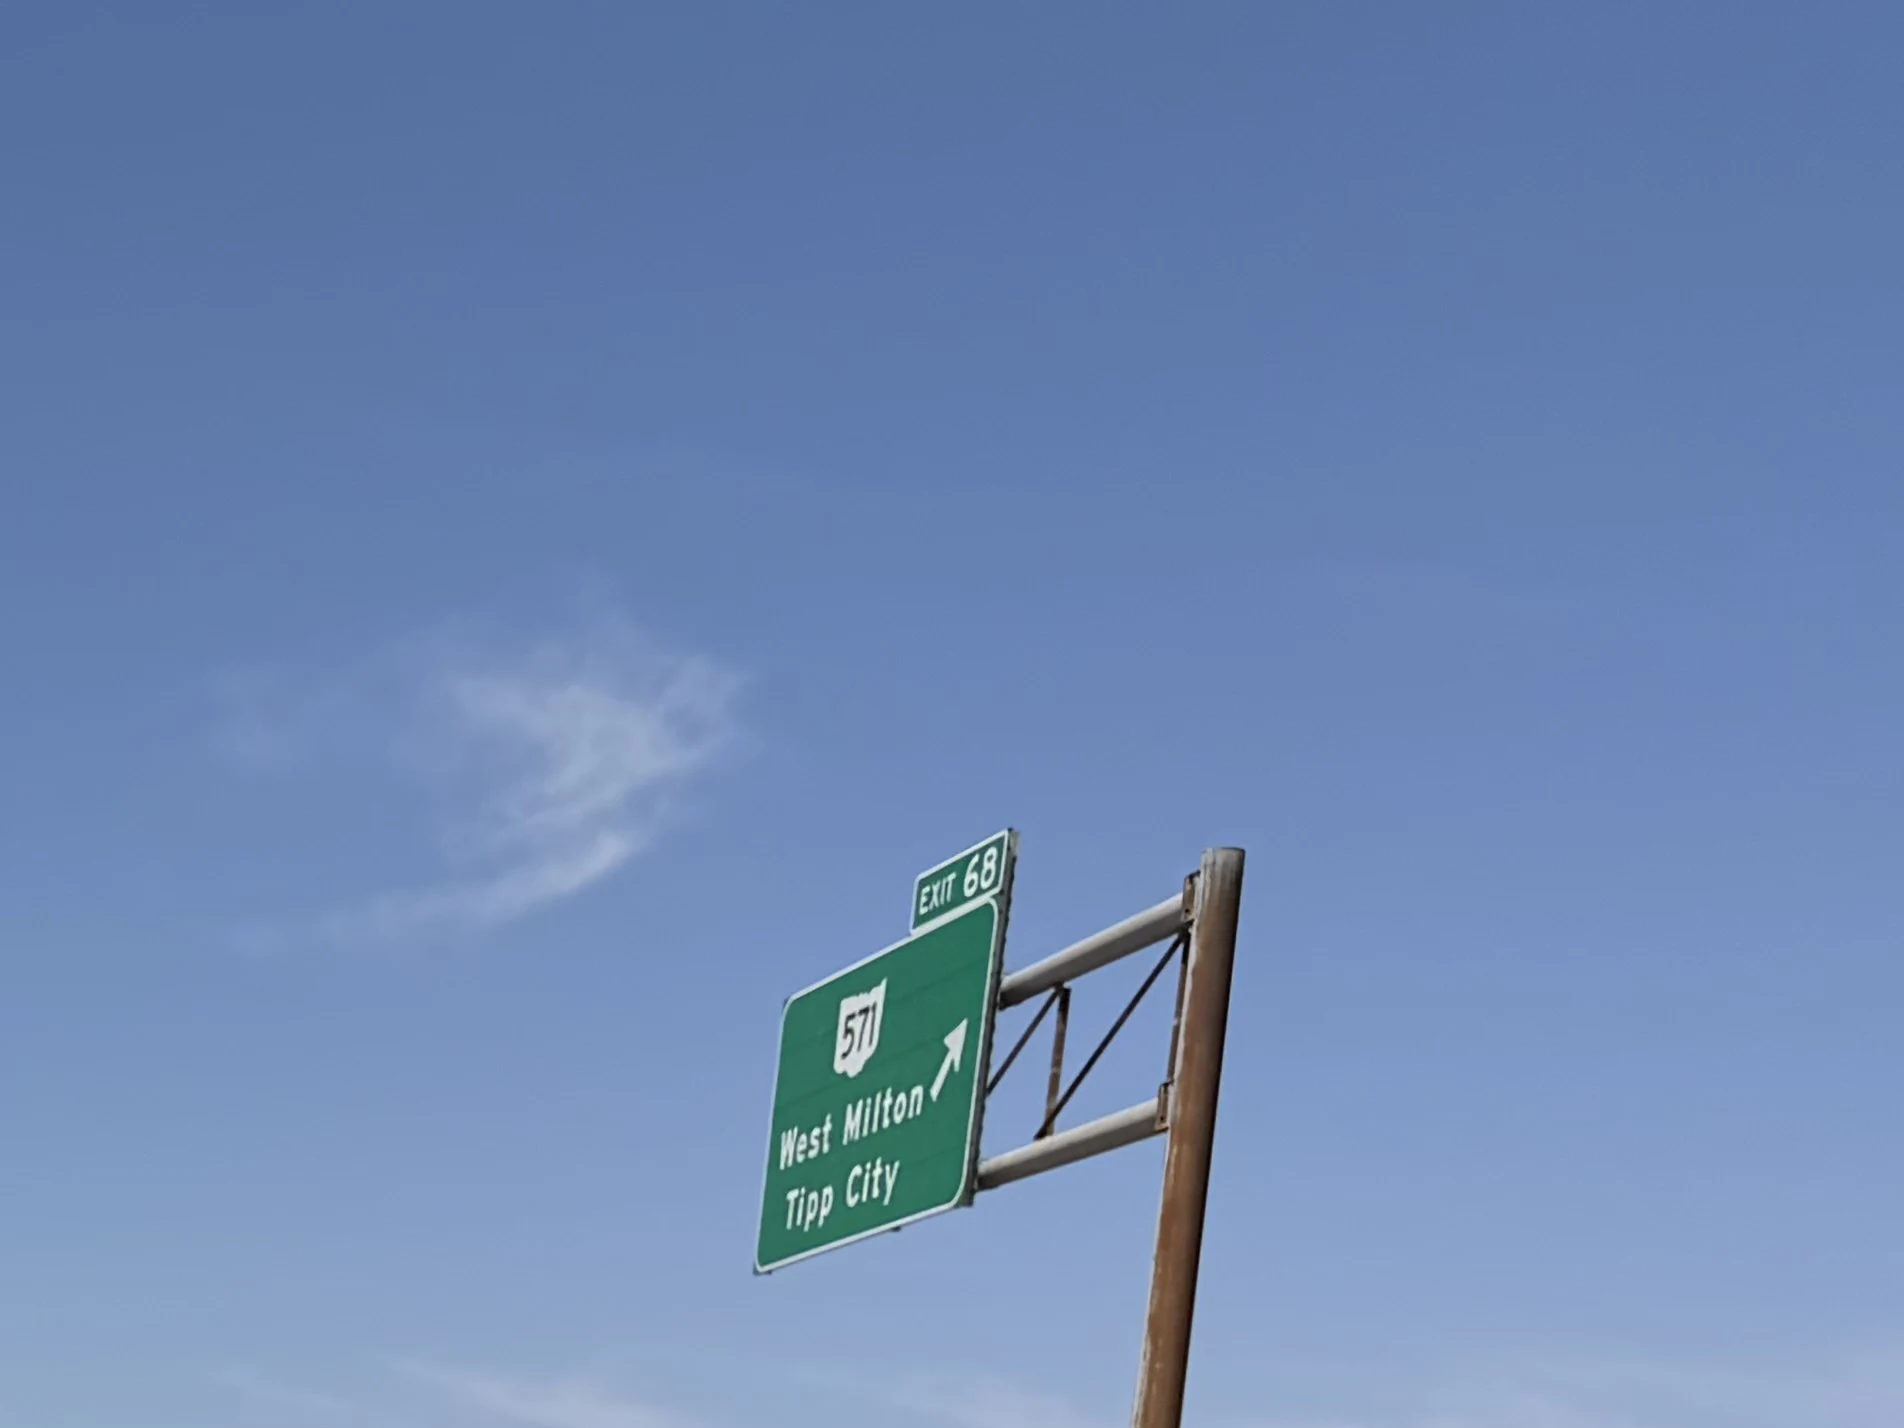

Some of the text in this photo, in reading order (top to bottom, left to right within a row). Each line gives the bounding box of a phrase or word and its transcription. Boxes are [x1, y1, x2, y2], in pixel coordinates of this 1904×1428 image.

[917, 845, 998, 915] EXIT 68
[840, 1000, 878, 1061] 571
[779, 1083, 924, 1170] West Milton
[785, 1158, 901, 1231] Tipp City
